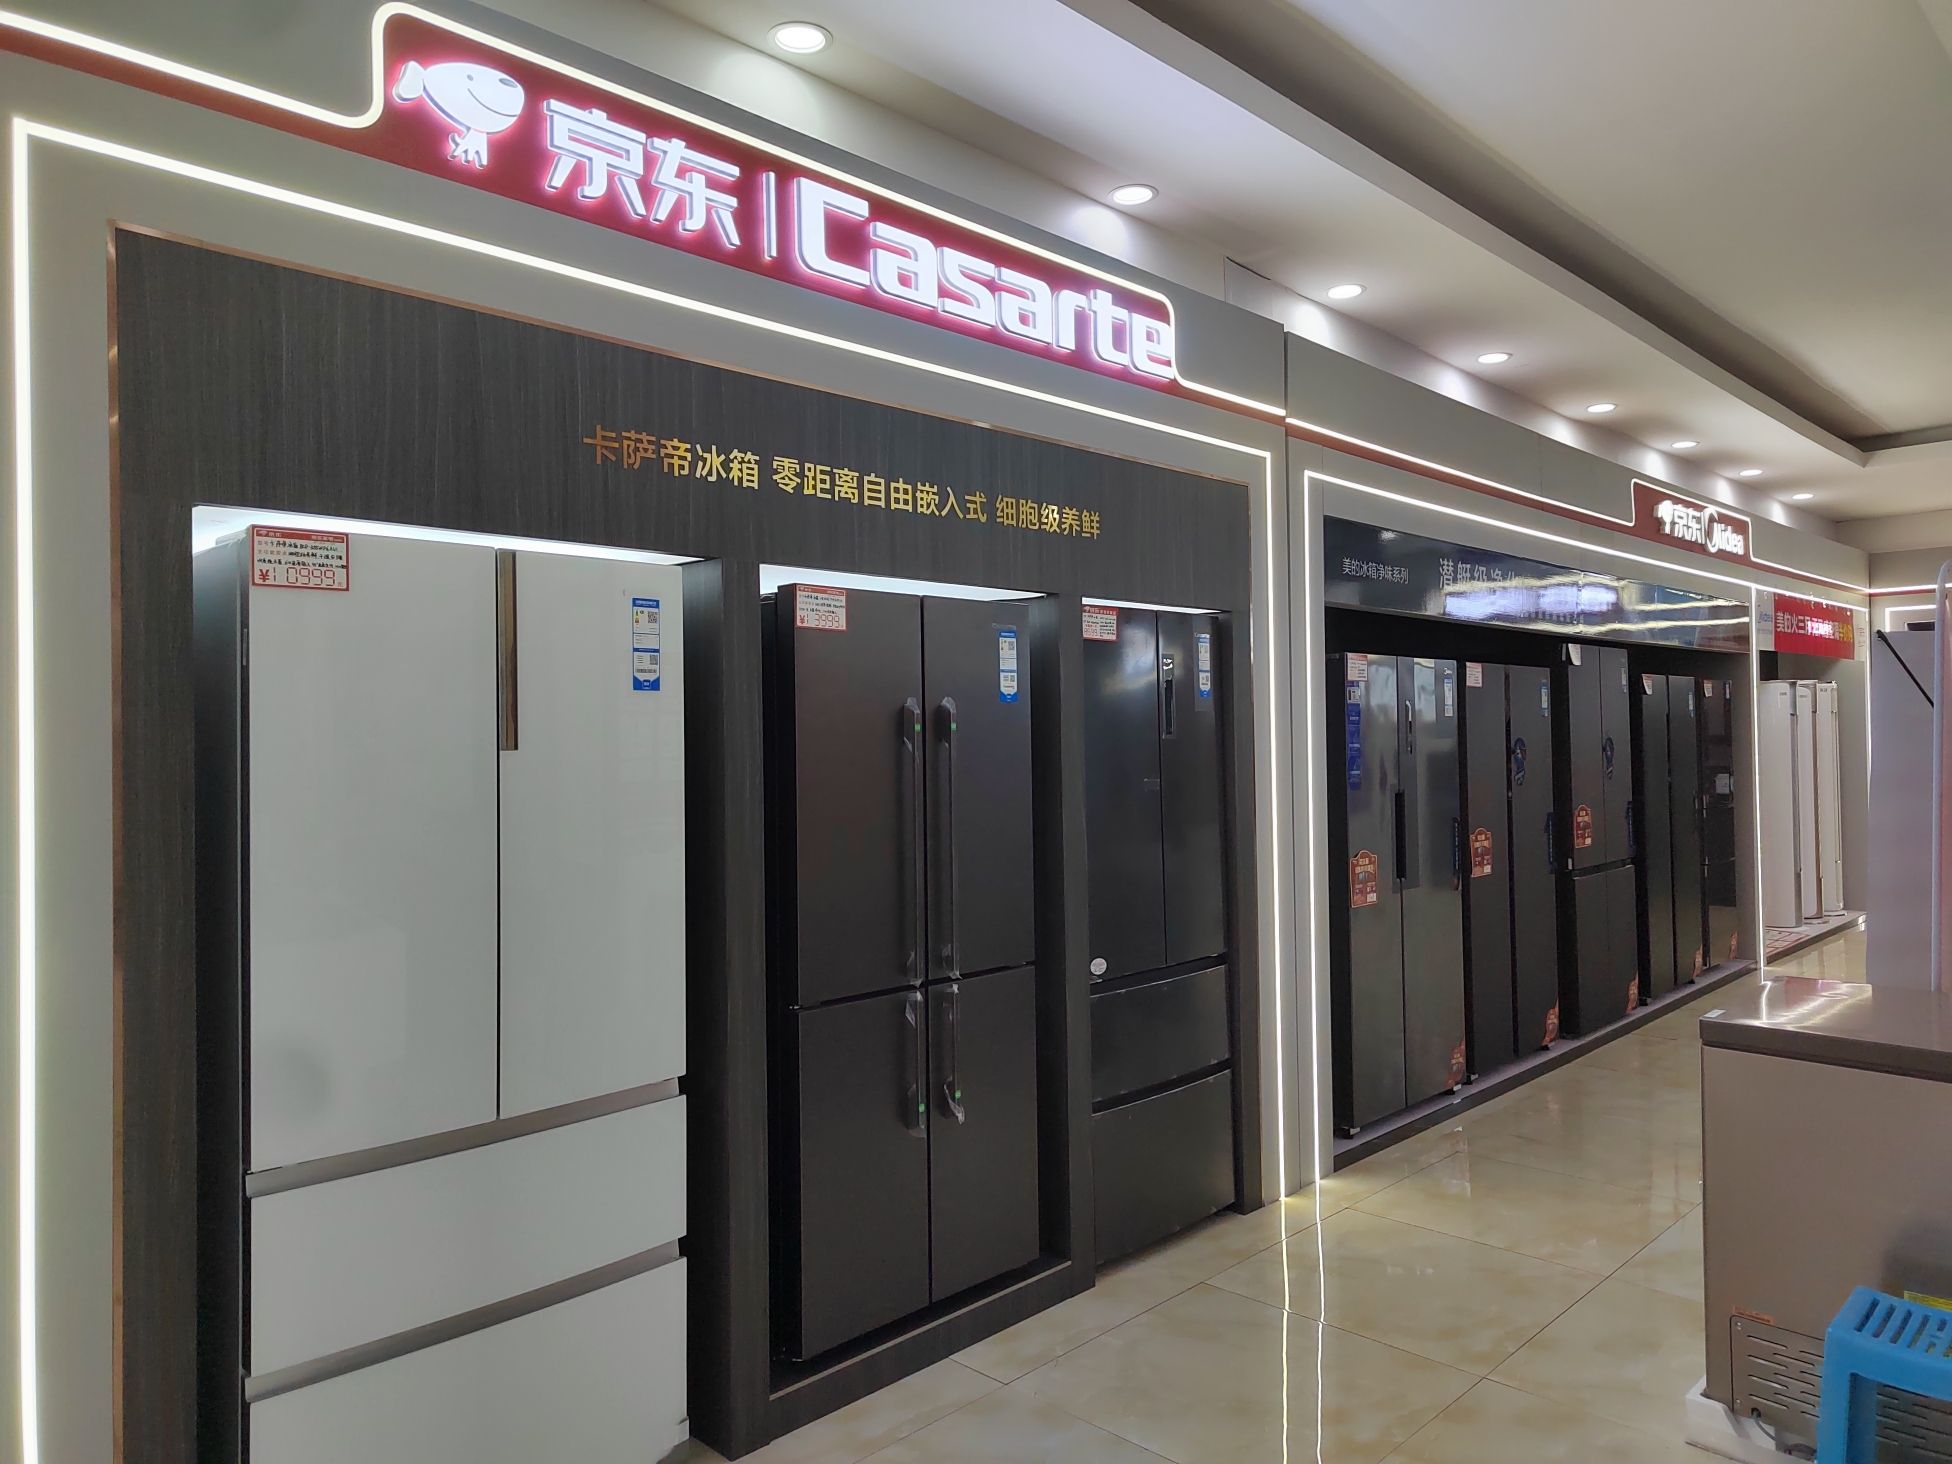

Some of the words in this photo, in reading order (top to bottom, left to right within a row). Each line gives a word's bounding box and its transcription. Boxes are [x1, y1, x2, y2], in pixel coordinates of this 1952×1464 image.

[544, 98, 743, 248] 京东
[794, 174, 1174, 380] Casarte
[583, 424, 760, 490] 卡萨帝冰箱
[772, 456, 988, 524] 零距离自由嵌入式
[995, 494, 1102, 540] 细胞级养鲜
[1673, 503, 1702, 543] 京东
[1342, 556, 1409, 585] 美的冰箱净味系列
[1704, 507, 1745, 555] Midea
